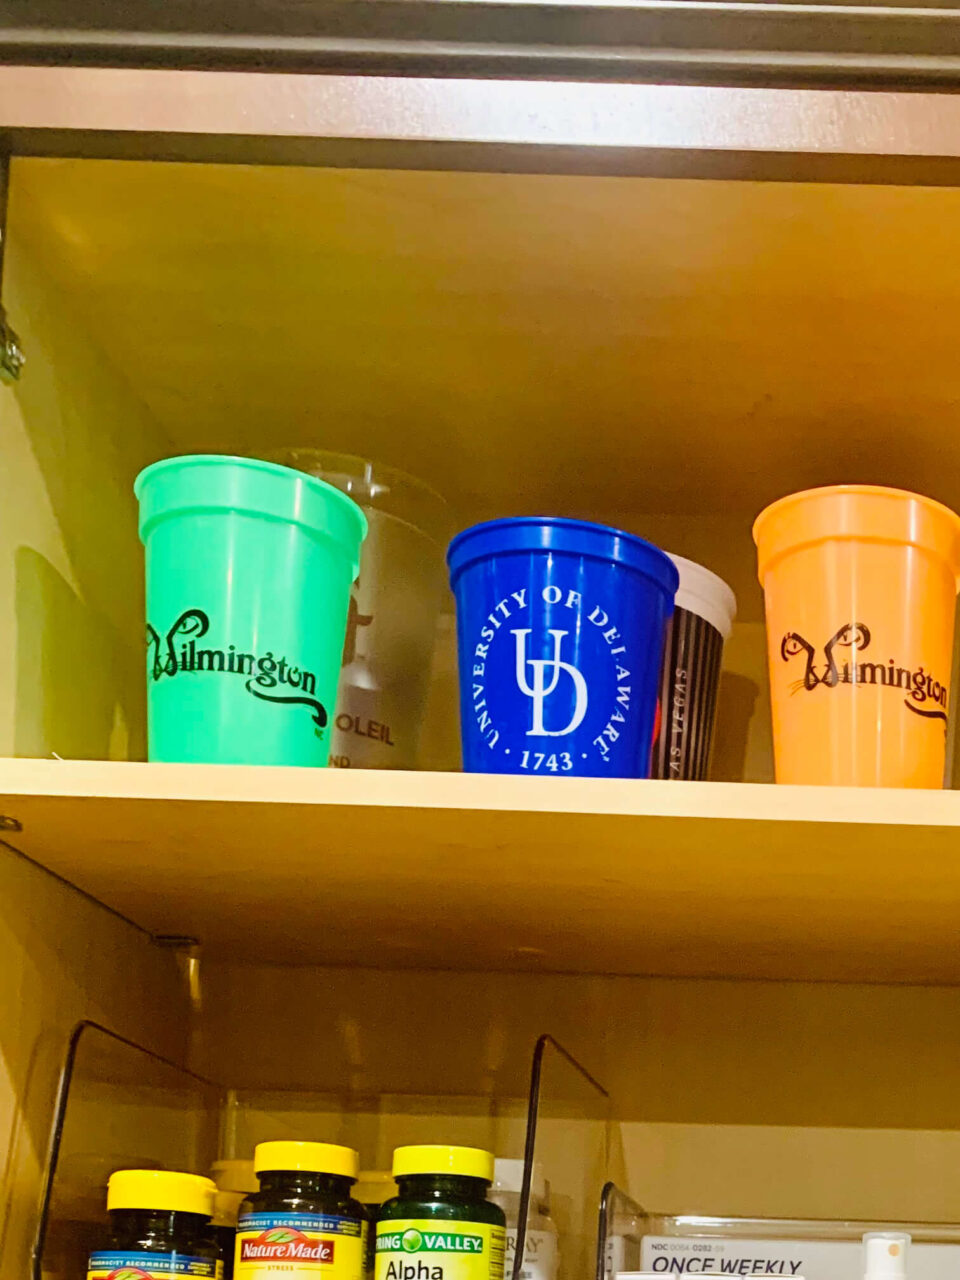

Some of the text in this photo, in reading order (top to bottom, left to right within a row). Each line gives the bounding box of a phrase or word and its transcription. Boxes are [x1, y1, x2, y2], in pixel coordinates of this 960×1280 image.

[473, 589, 527, 749] UNIVERSITY
[542, 585, 582, 609] OF
[520, 750, 573, 771] 1743
[424, 1235, 481, 1250] VALLEY
